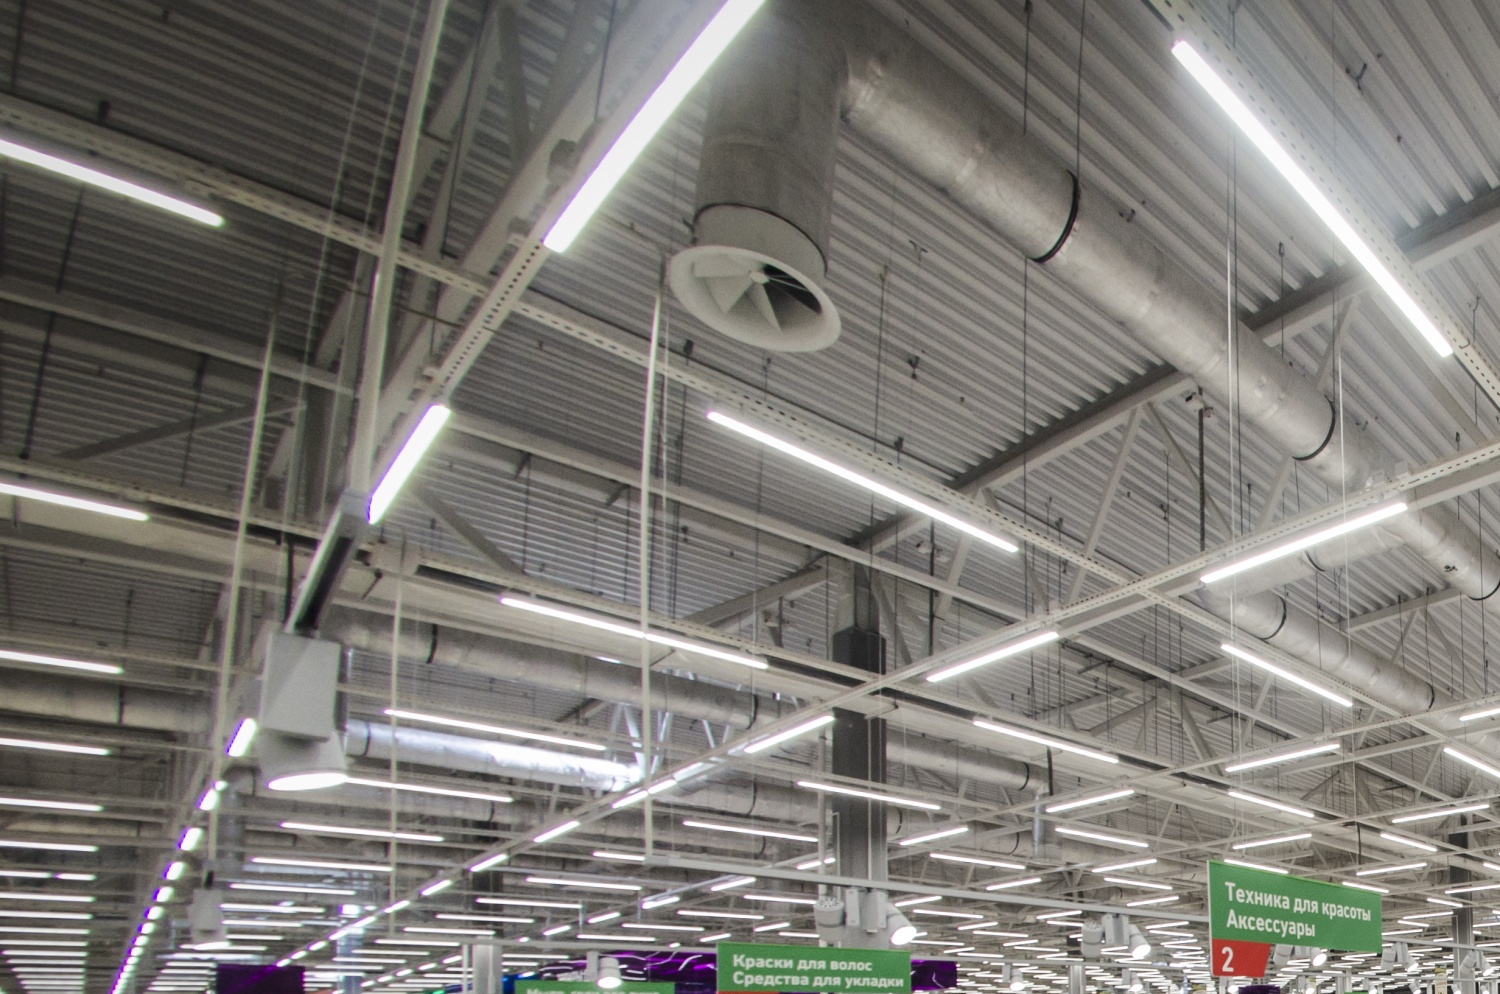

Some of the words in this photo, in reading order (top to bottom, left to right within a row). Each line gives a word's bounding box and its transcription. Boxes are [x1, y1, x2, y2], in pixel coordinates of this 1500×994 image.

[1225, 881, 1290, 910] Техника
[1293, 897, 1319, 914] для
[1322, 902, 1371, 922] красоты
[1226, 908, 1316, 939] Аксессуары
[732, 954, 793, 971] Краски
[797, 957, 826, 971] для
[830, 960, 873, 972] волос
[1221, 946, 1235, 972] 2
[732, 971, 809, 987] Средства
[812, 974, 841, 988] для
[845, 976, 904, 989] укладки
